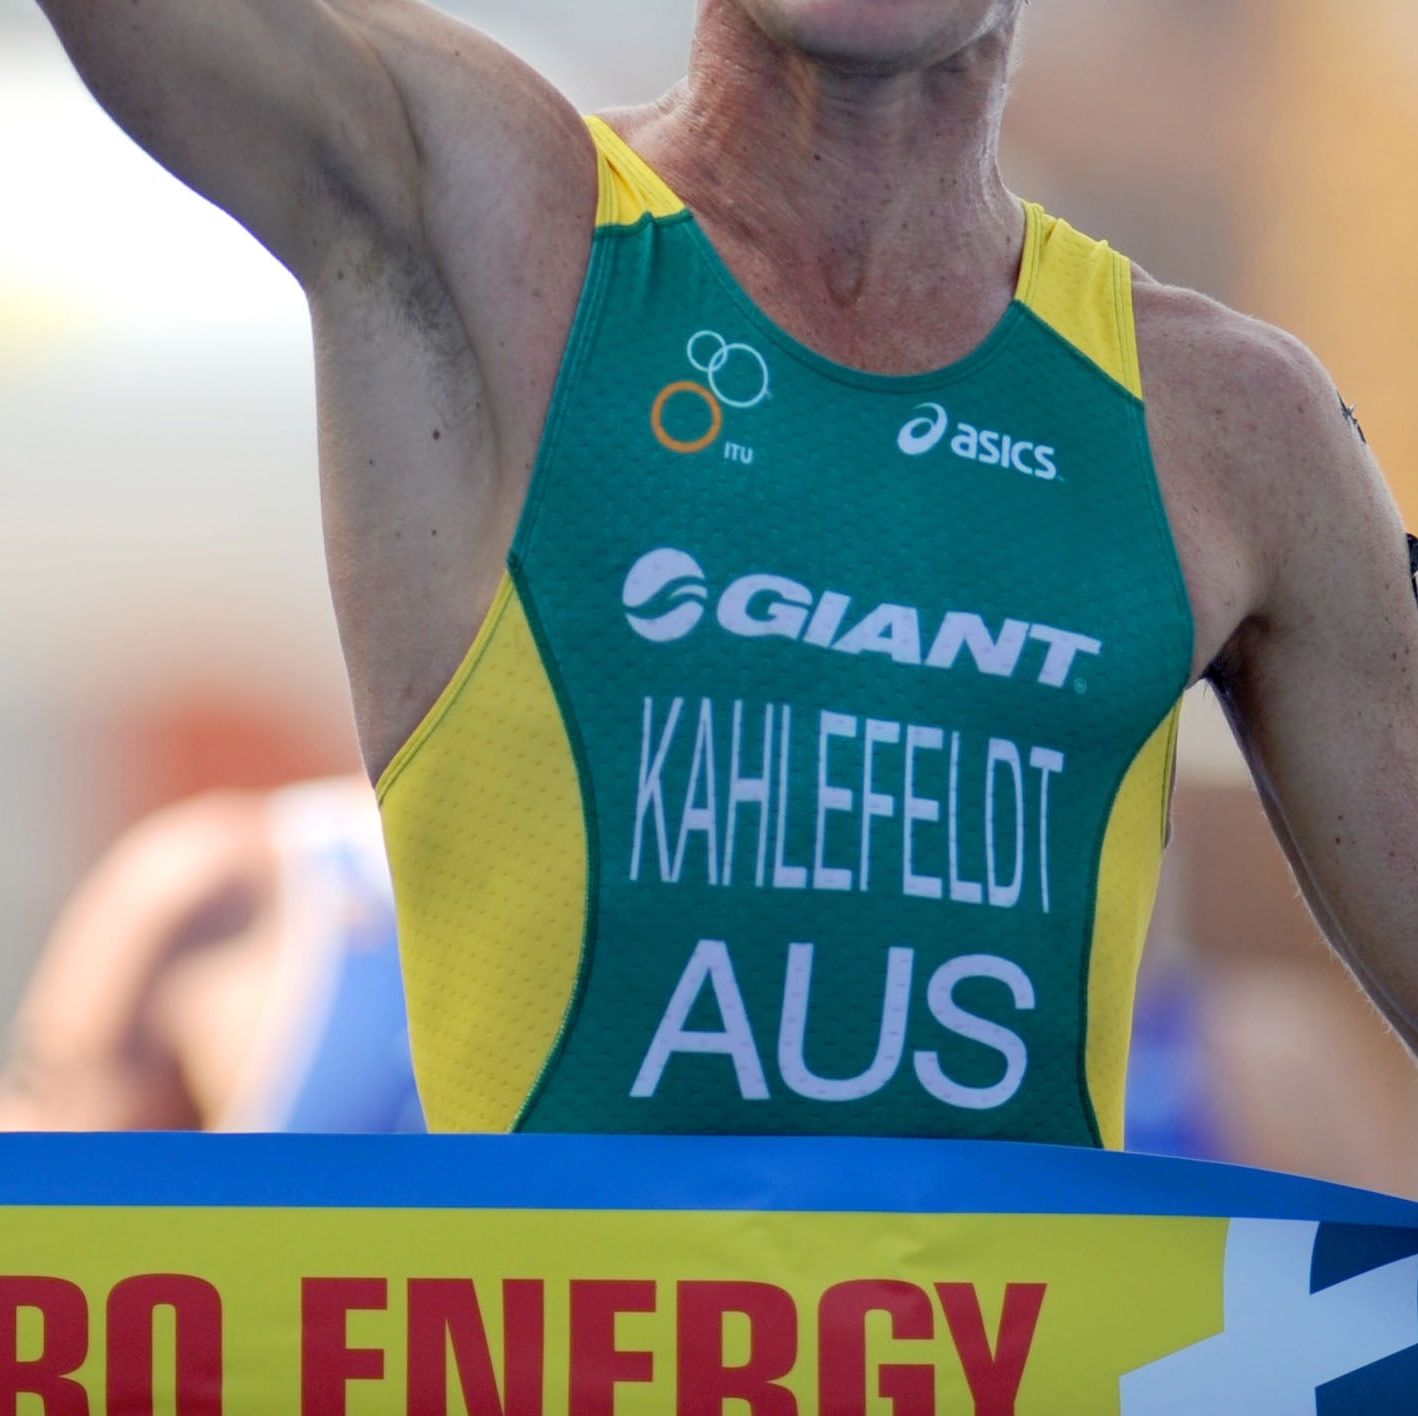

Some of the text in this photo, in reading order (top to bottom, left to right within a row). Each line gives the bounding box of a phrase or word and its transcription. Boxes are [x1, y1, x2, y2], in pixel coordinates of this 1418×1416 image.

[723, 441, 754, 464] ITU
[716, 572, 1102, 689] GIANT
[629, 696, 1064, 914] KAHLEFELDT
[629, 939, 1036, 1110] AUS
[300, 1276, 1048, 1416] ENERGY
